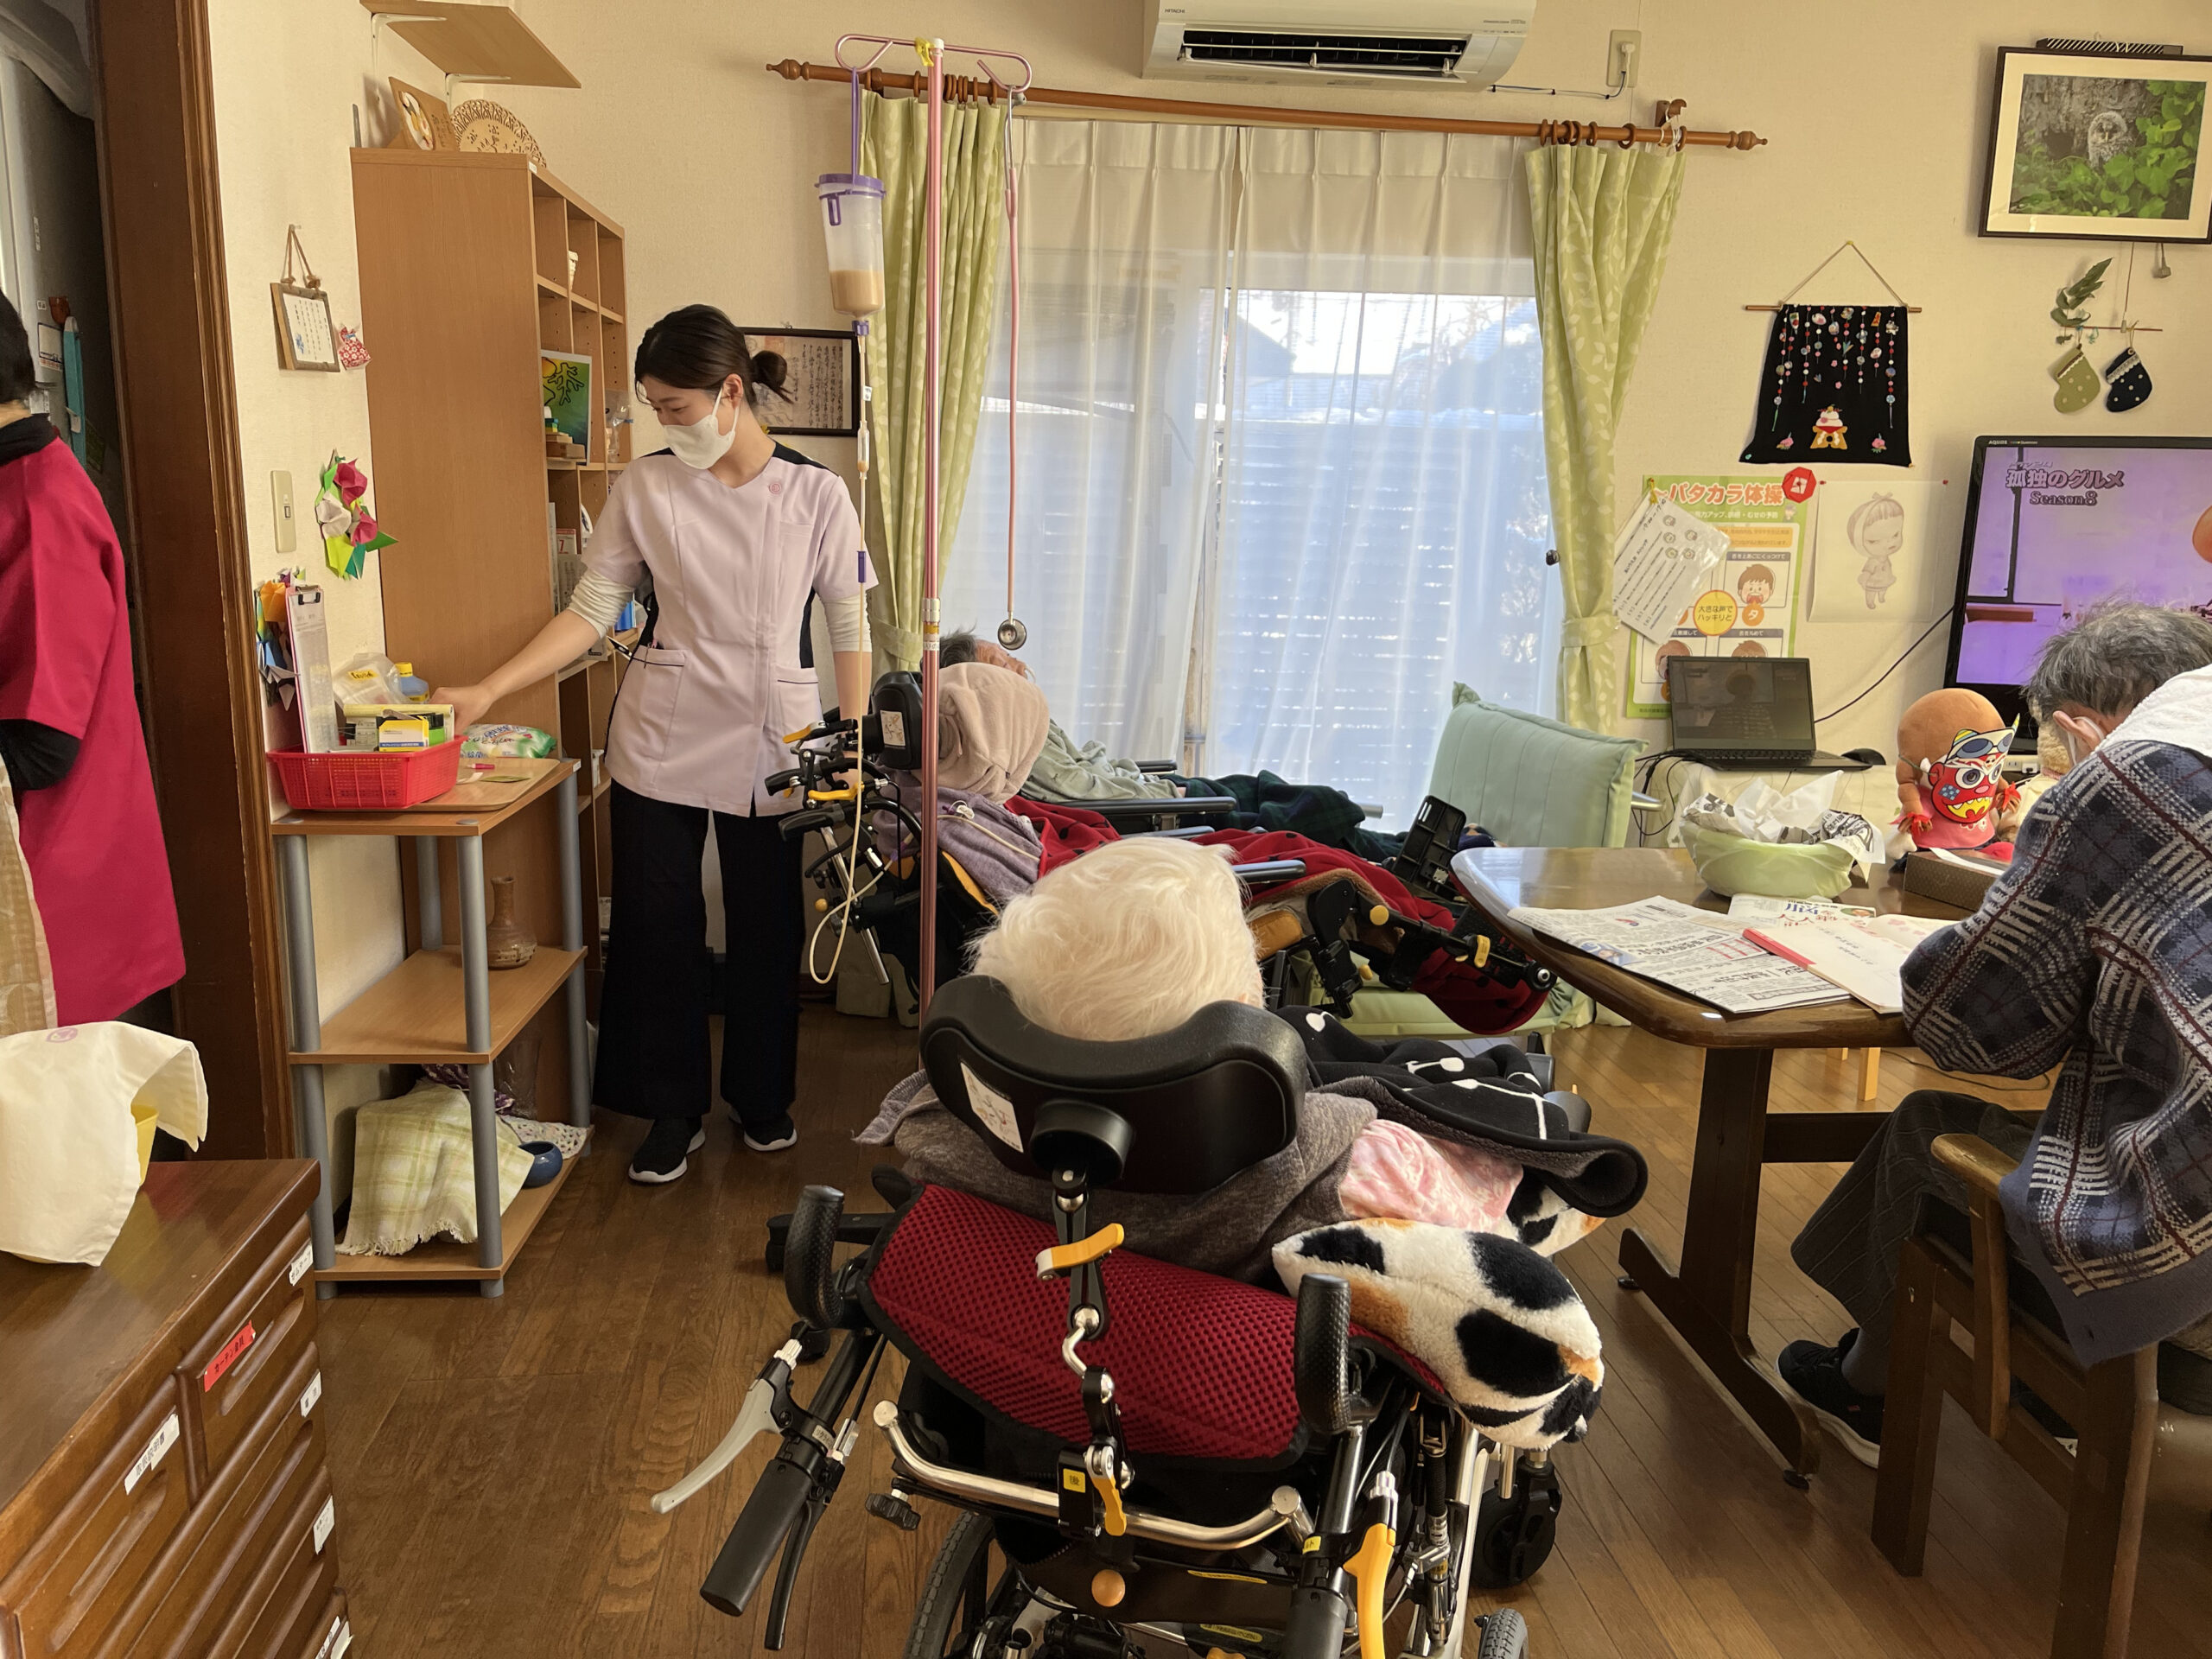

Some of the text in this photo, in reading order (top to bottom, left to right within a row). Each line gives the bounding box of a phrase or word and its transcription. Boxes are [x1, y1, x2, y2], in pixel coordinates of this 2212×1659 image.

[2005, 468, 2125, 490] 孤独のグルメ
[1748, 609, 1759, 620] タ
[213, 1334, 245, 1375] カーテン金具
[135, 1431, 165, 1477] 取扱説明書
